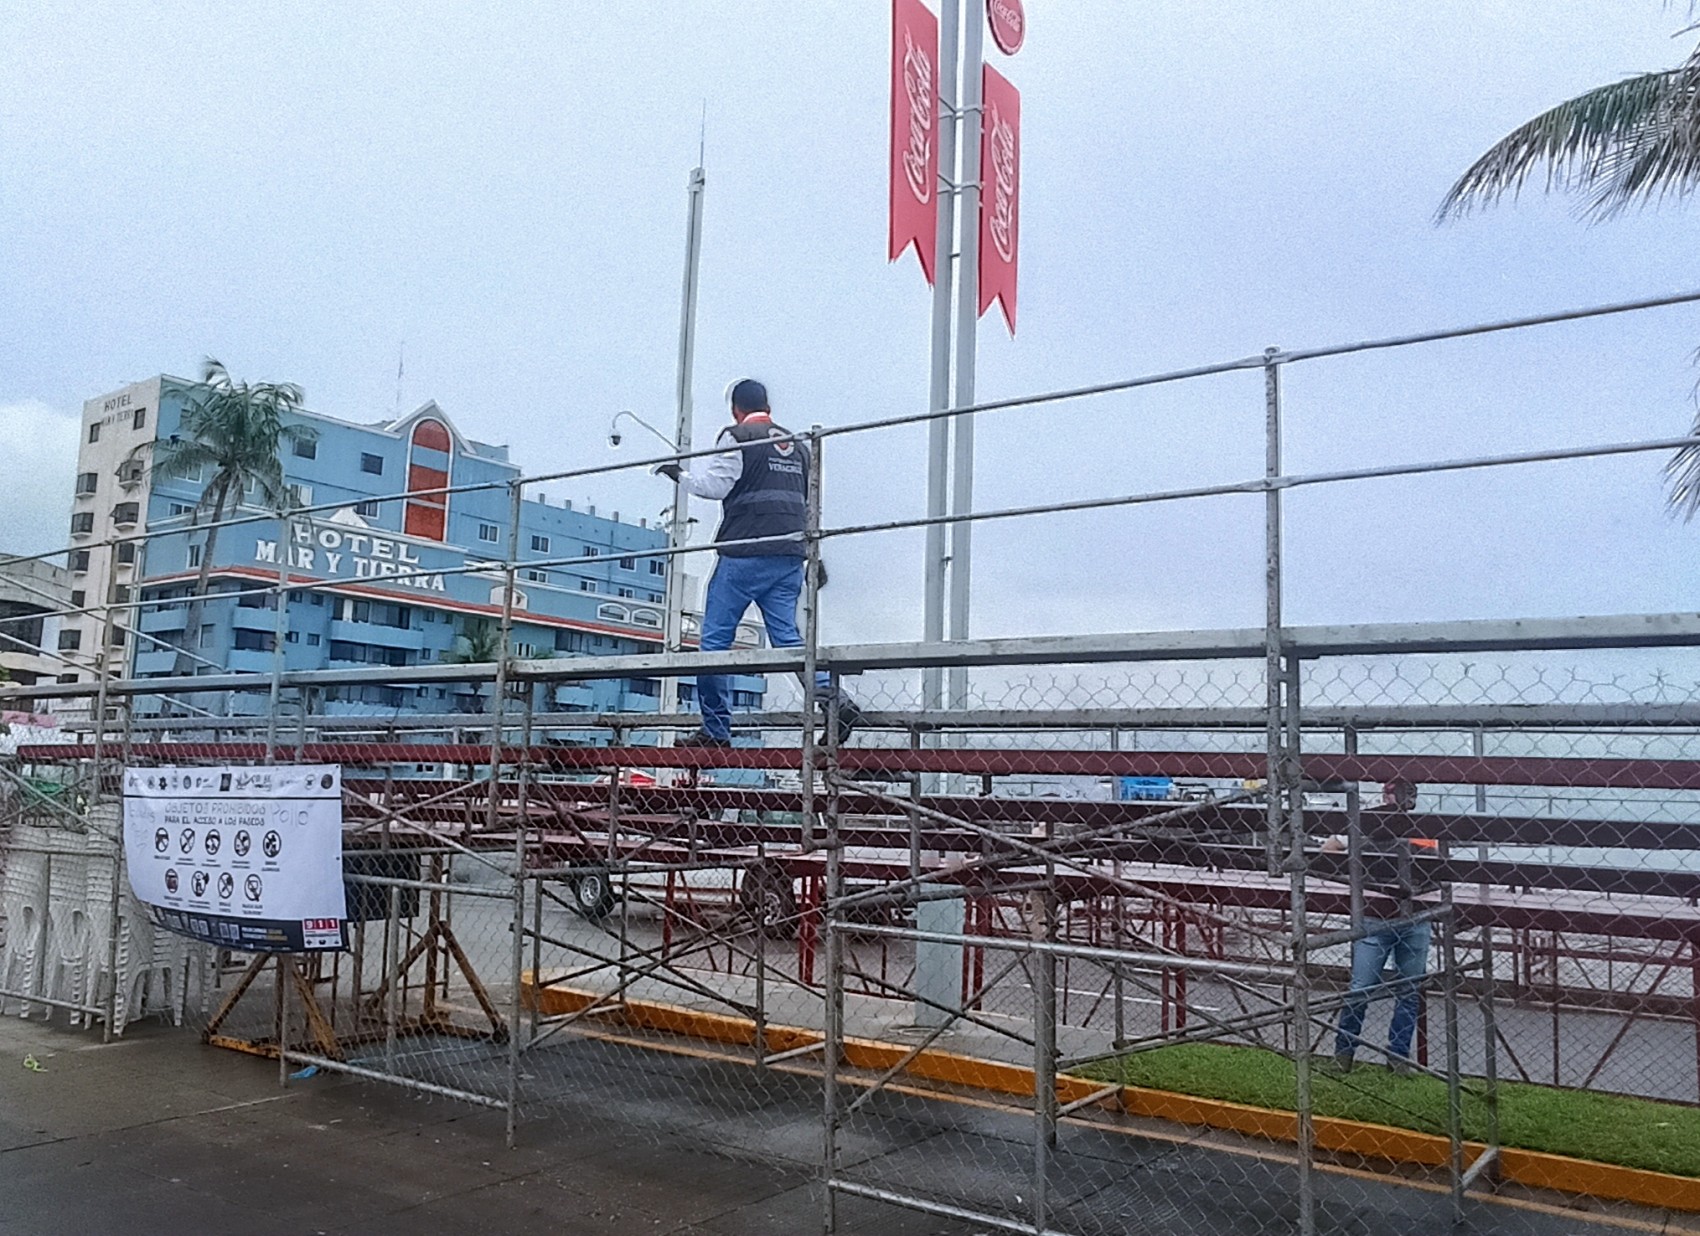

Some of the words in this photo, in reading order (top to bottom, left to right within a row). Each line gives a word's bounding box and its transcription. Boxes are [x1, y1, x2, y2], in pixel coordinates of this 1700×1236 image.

[903, 24, 931, 205] Coca-Cola
[990, 99, 1015, 264] Coca-Cola
[104, 393, 132, 412] HOTEL
[255, 539, 314, 570] MAR
[325, 551, 343, 574] Y
[353, 556, 446, 592] TIERRA
[293, 522, 420, 564] HOTEL
[306, 919, 336, 929] 911
